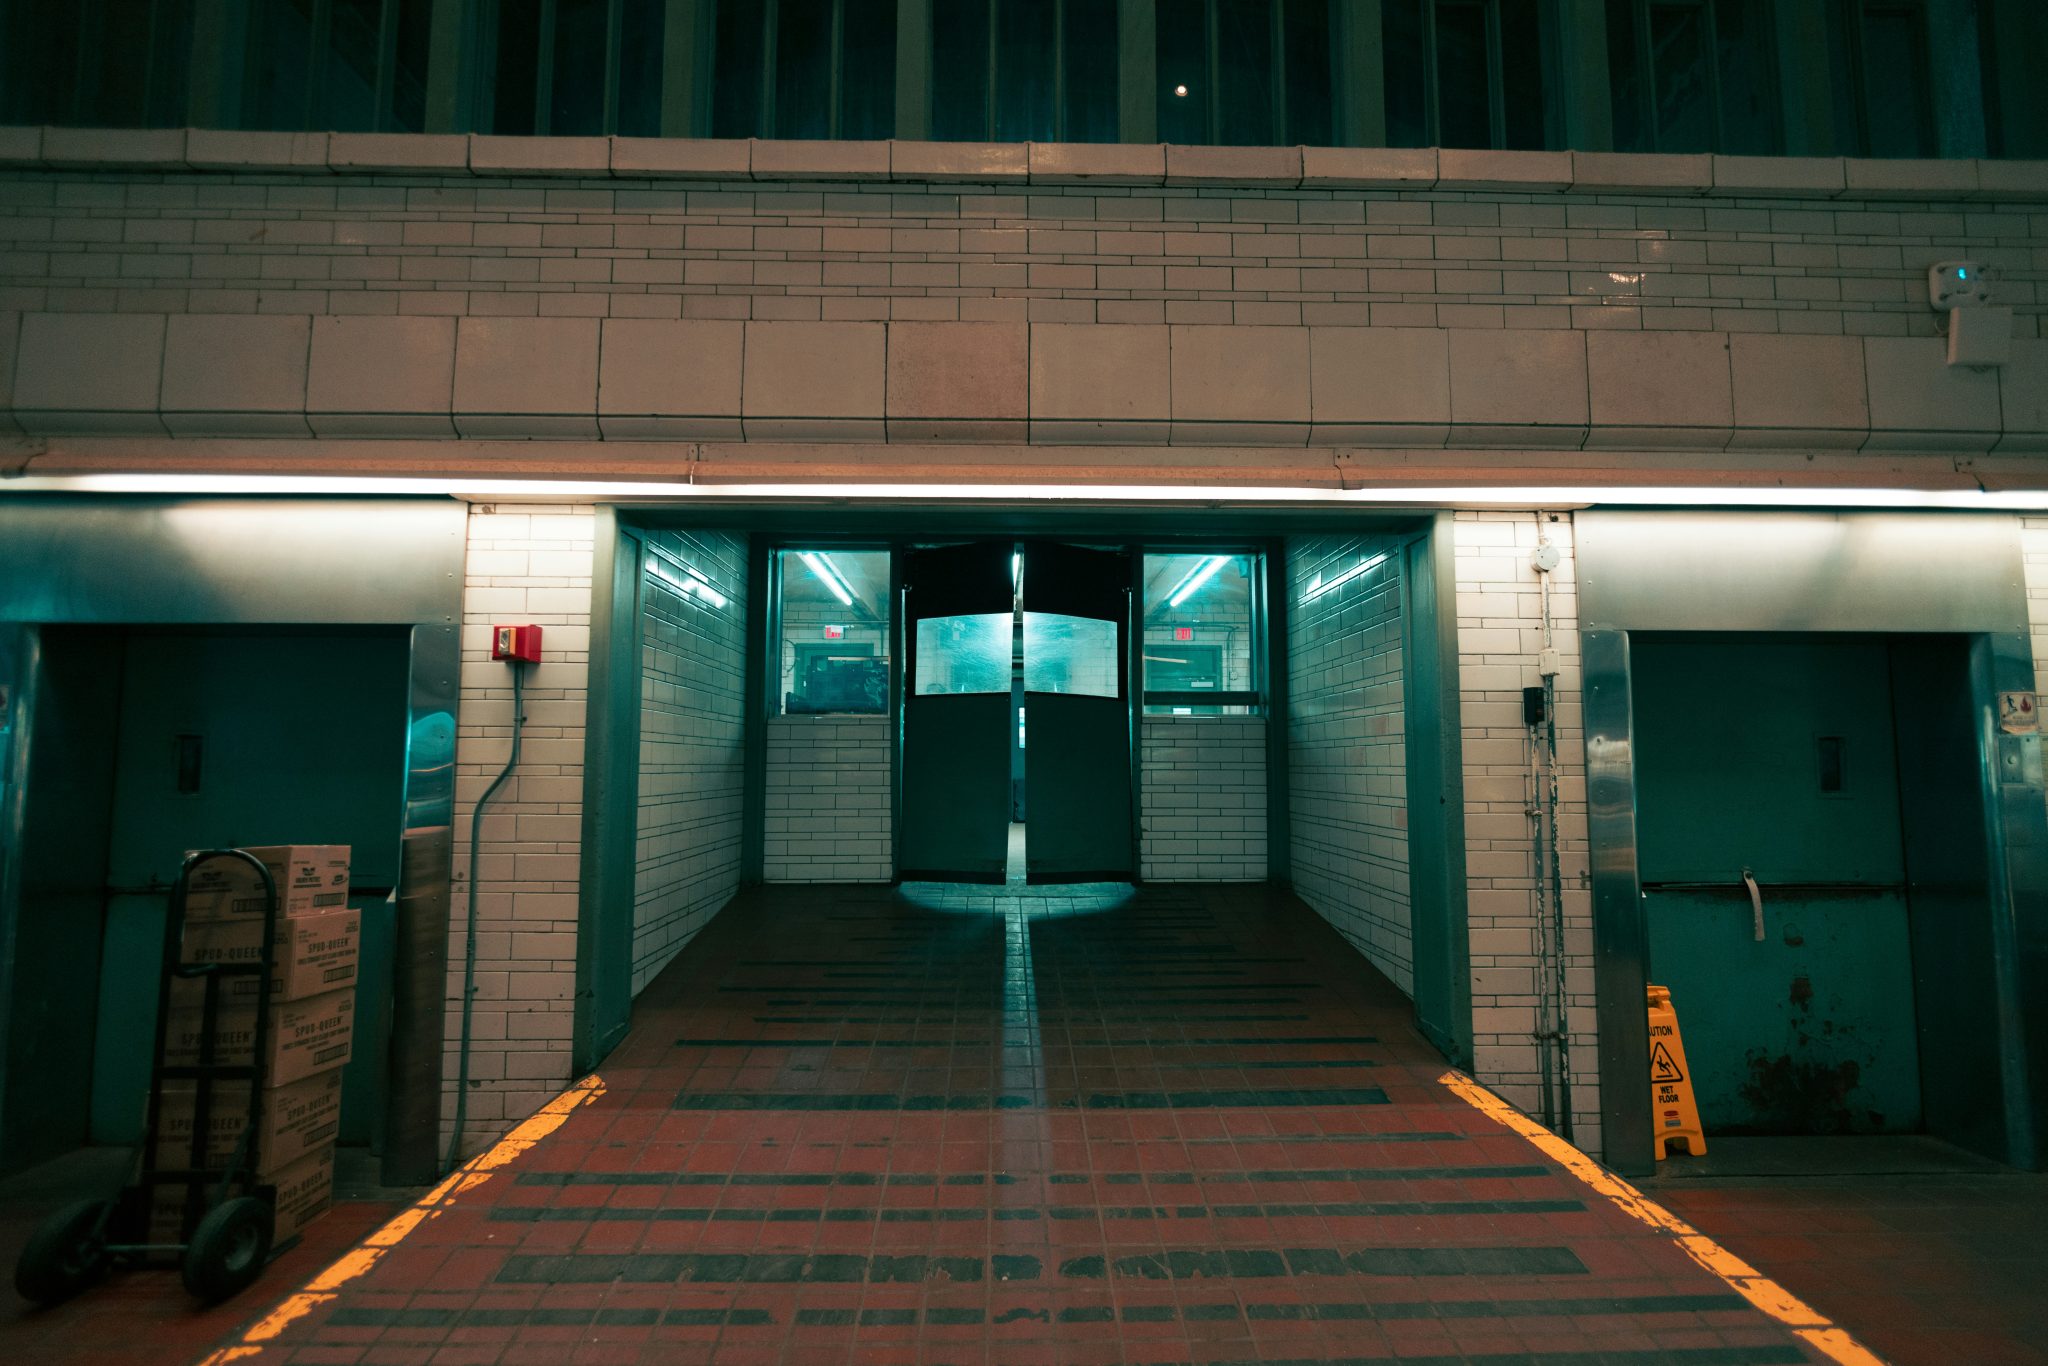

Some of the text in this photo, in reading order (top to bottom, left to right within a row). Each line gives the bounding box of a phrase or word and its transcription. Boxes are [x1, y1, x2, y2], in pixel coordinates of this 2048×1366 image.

[308, 938, 349, 954] SPUD-QUEEN
[295, 1016, 342, 1038] SPUD-QUEEN
[1650, 1025, 1673, 1036] UTION
[182, 1031, 251, 1046] SPUQUEEN
[1660, 1086, 1673, 1094] WET
[1658, 1095, 1679, 1103] FLOOR
